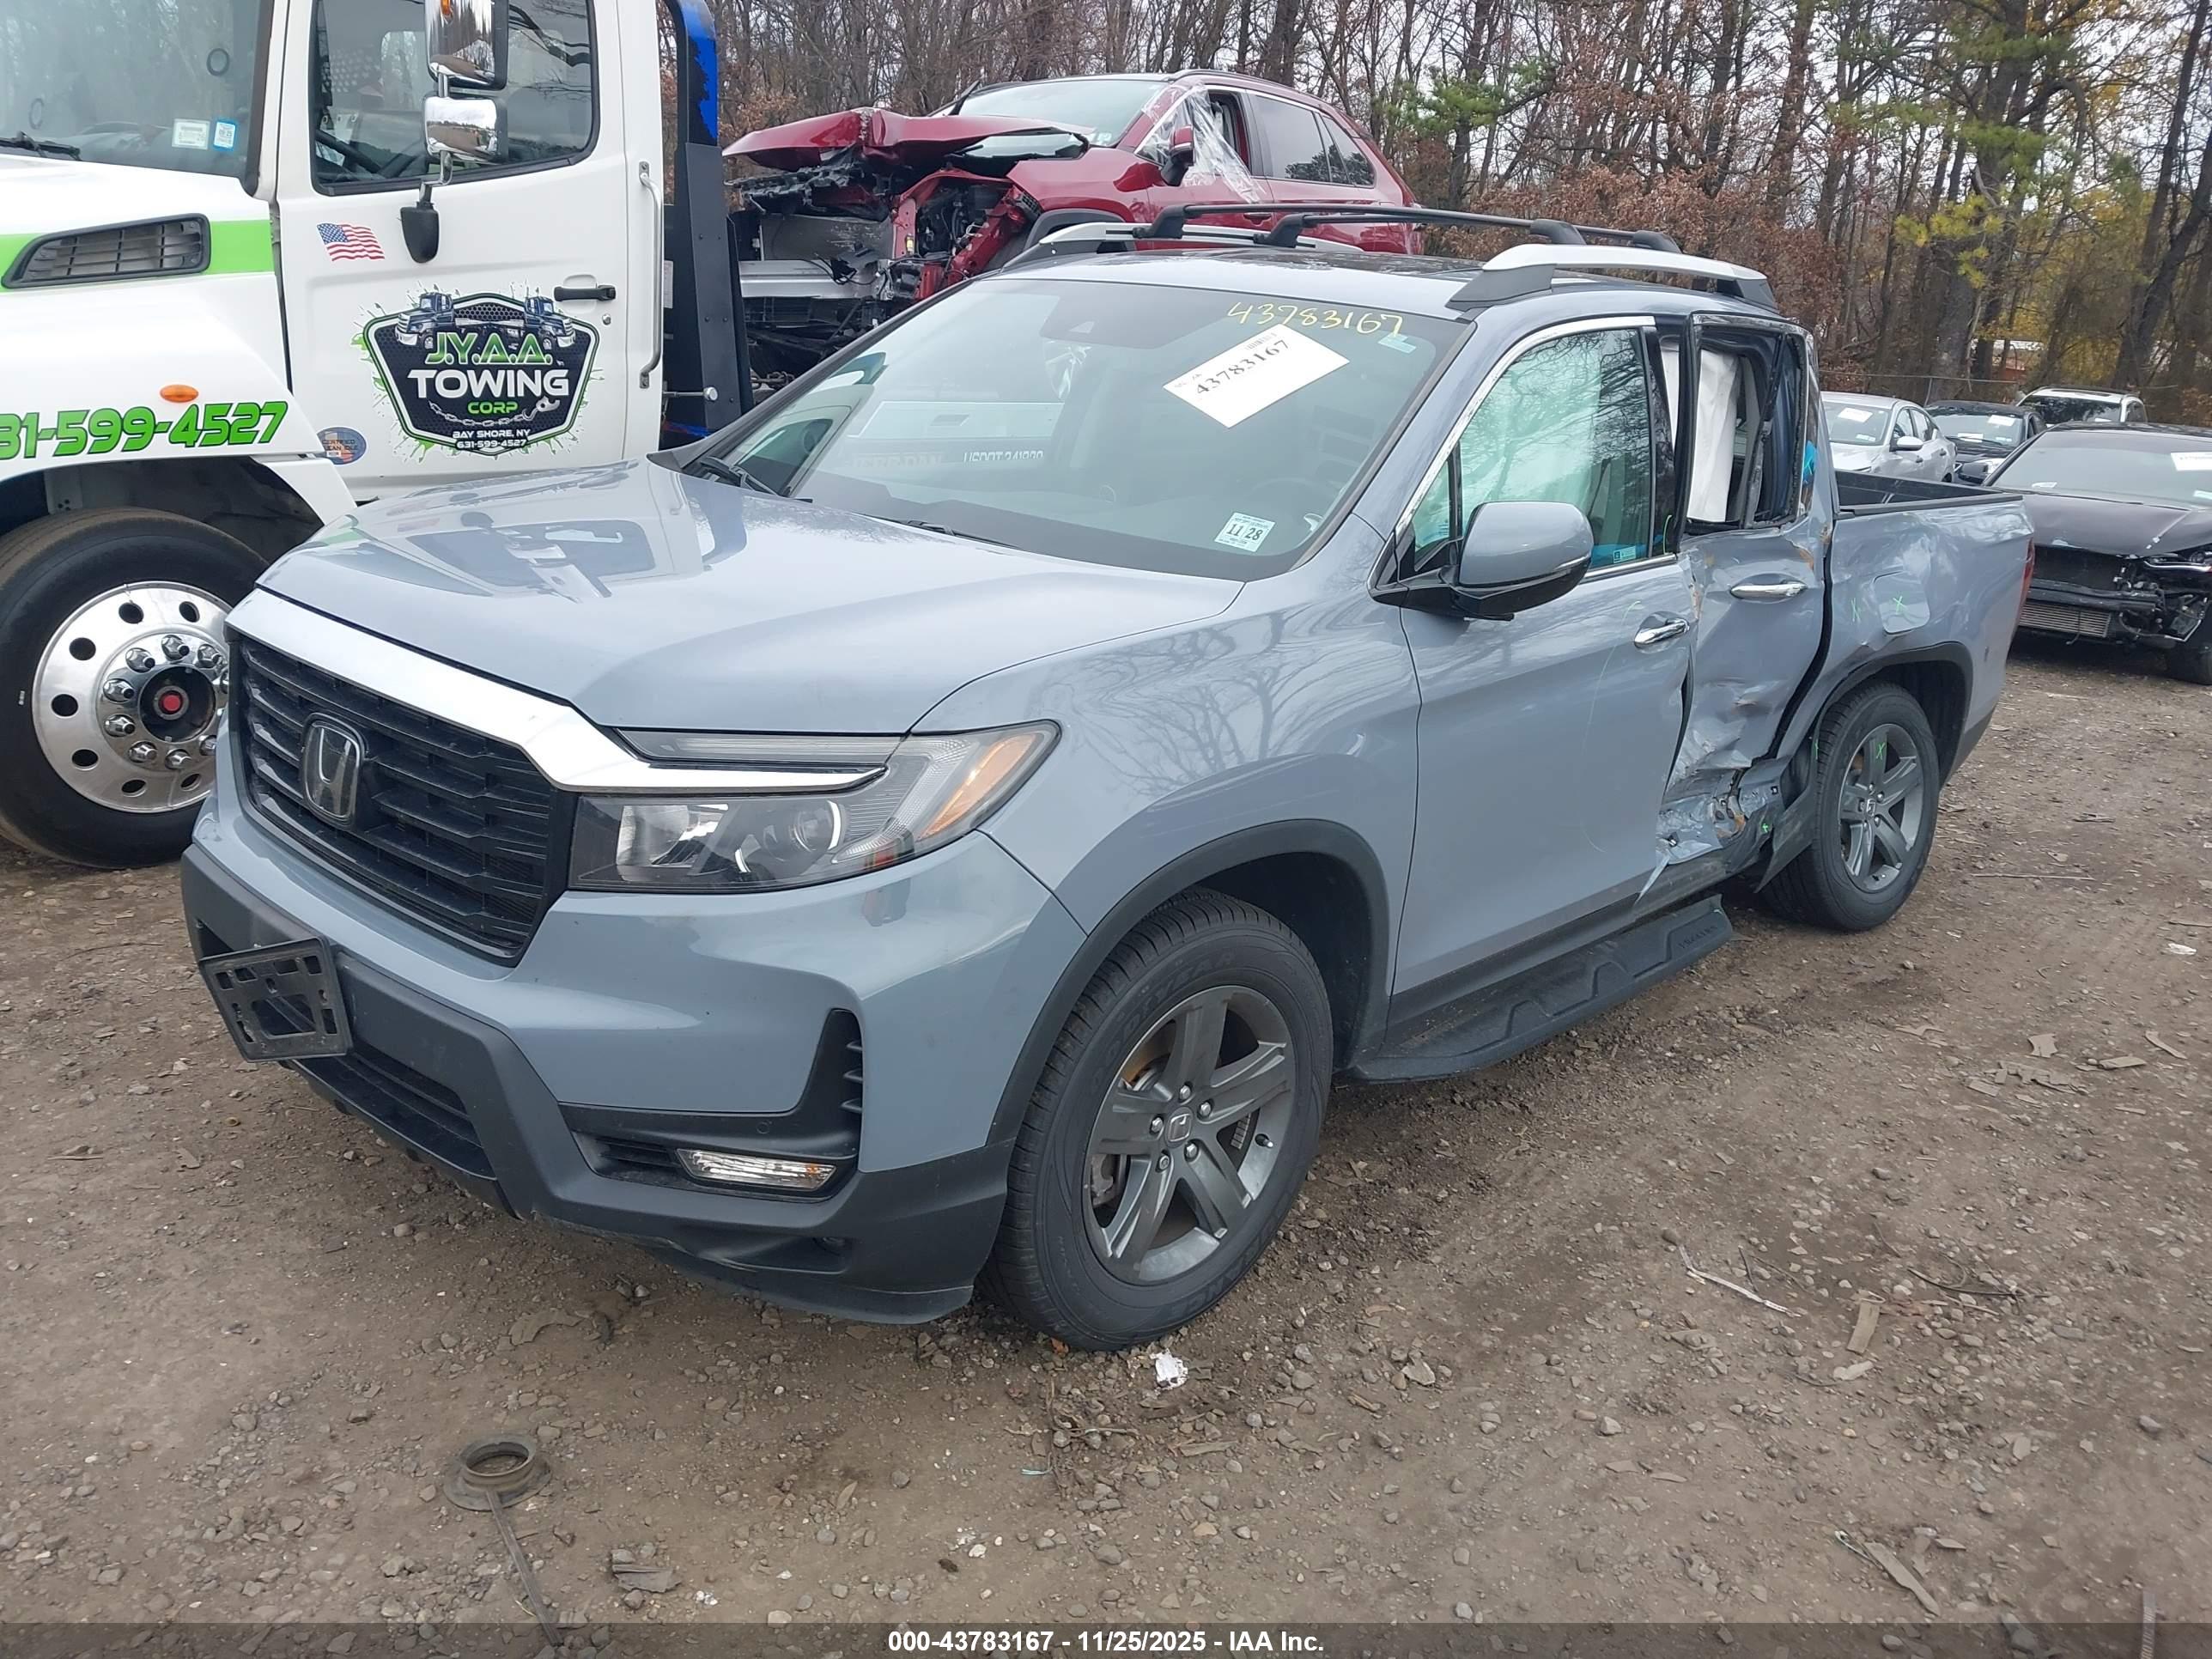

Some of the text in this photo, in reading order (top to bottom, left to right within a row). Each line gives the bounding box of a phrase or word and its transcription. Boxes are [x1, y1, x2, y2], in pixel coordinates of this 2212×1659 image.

[1227, 301, 1403, 337] 43783167
[424, 331, 554, 366] J.Y.A.A.
[1196, 339, 1289, 395] 43783167
[407, 369, 569, 399] TOWING
[467, 401, 519, 415] CORP
[452, 430, 474, 439] BAY
[515, 428, 531, 437] NY
[456, 439, 527, 449] 631-599-4527
[1226, 523, 1263, 540] 11 28
